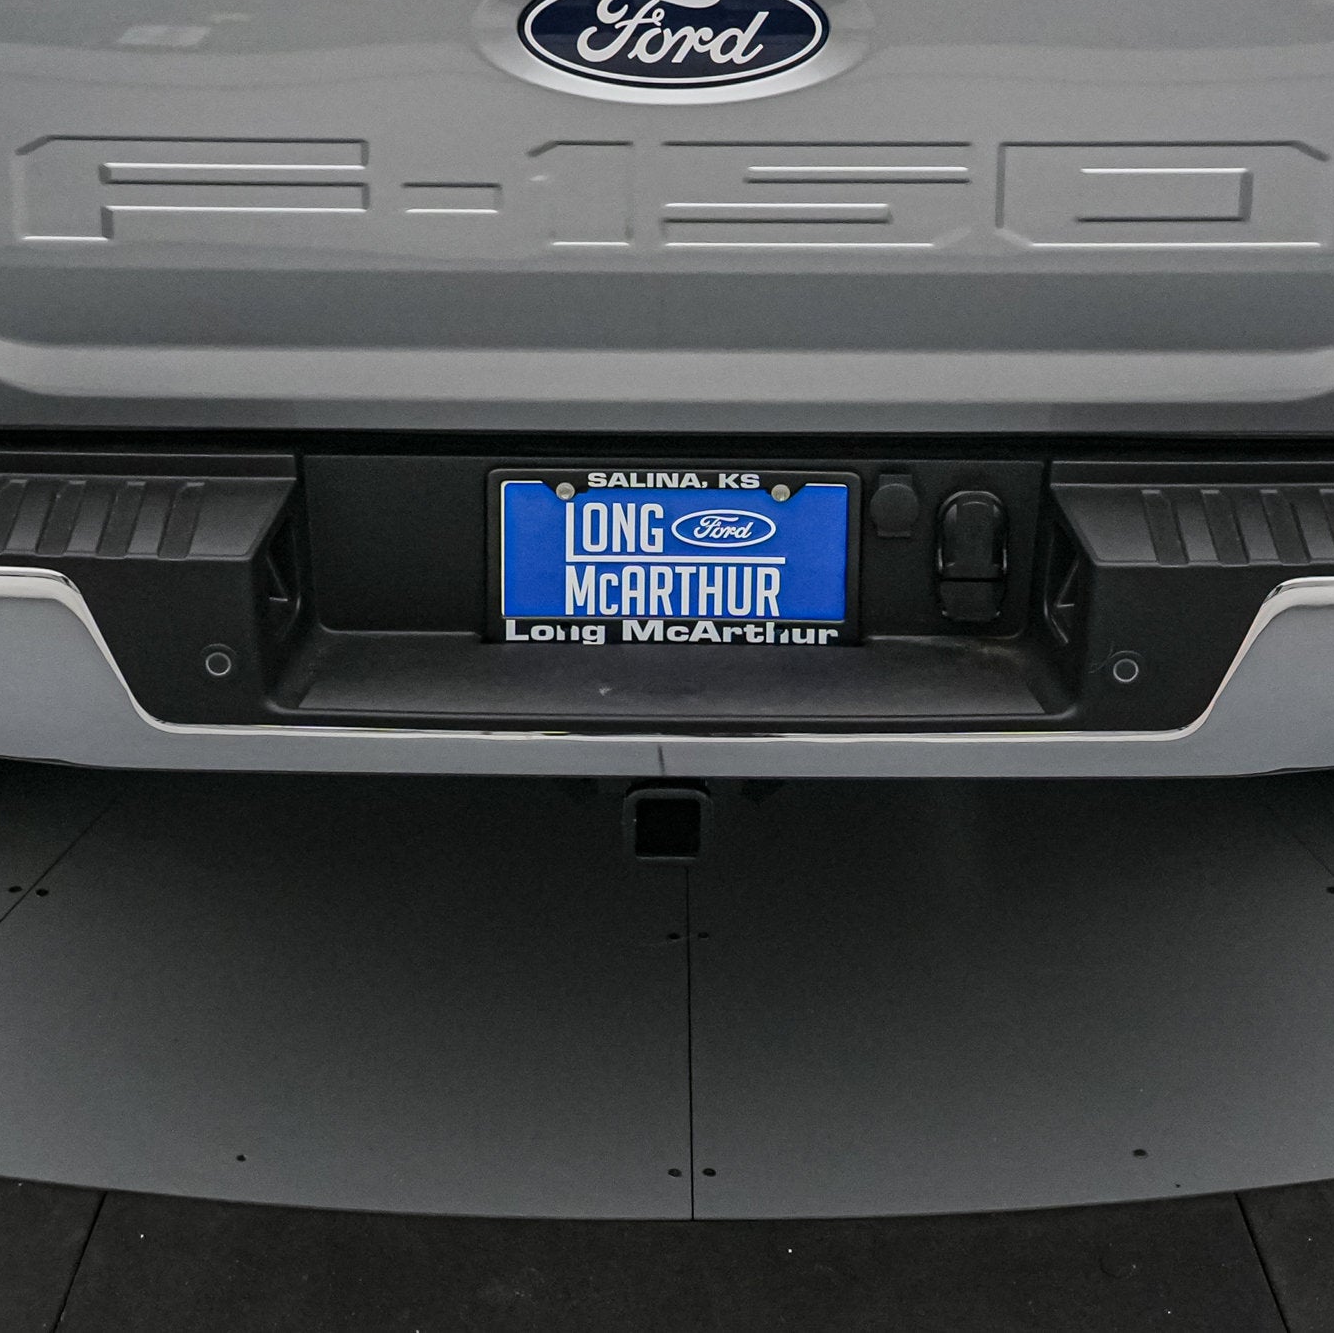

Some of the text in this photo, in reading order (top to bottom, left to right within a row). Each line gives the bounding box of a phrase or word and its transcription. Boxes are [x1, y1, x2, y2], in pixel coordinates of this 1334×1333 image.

[13, 135, 1331, 249] F-150
[587, 471, 761, 489] SALINA, KS
[565, 501, 754, 558] LONG Ford
[565, 565, 781, 618] McARTHUR
[504, 619, 839, 646] Long McArthur
